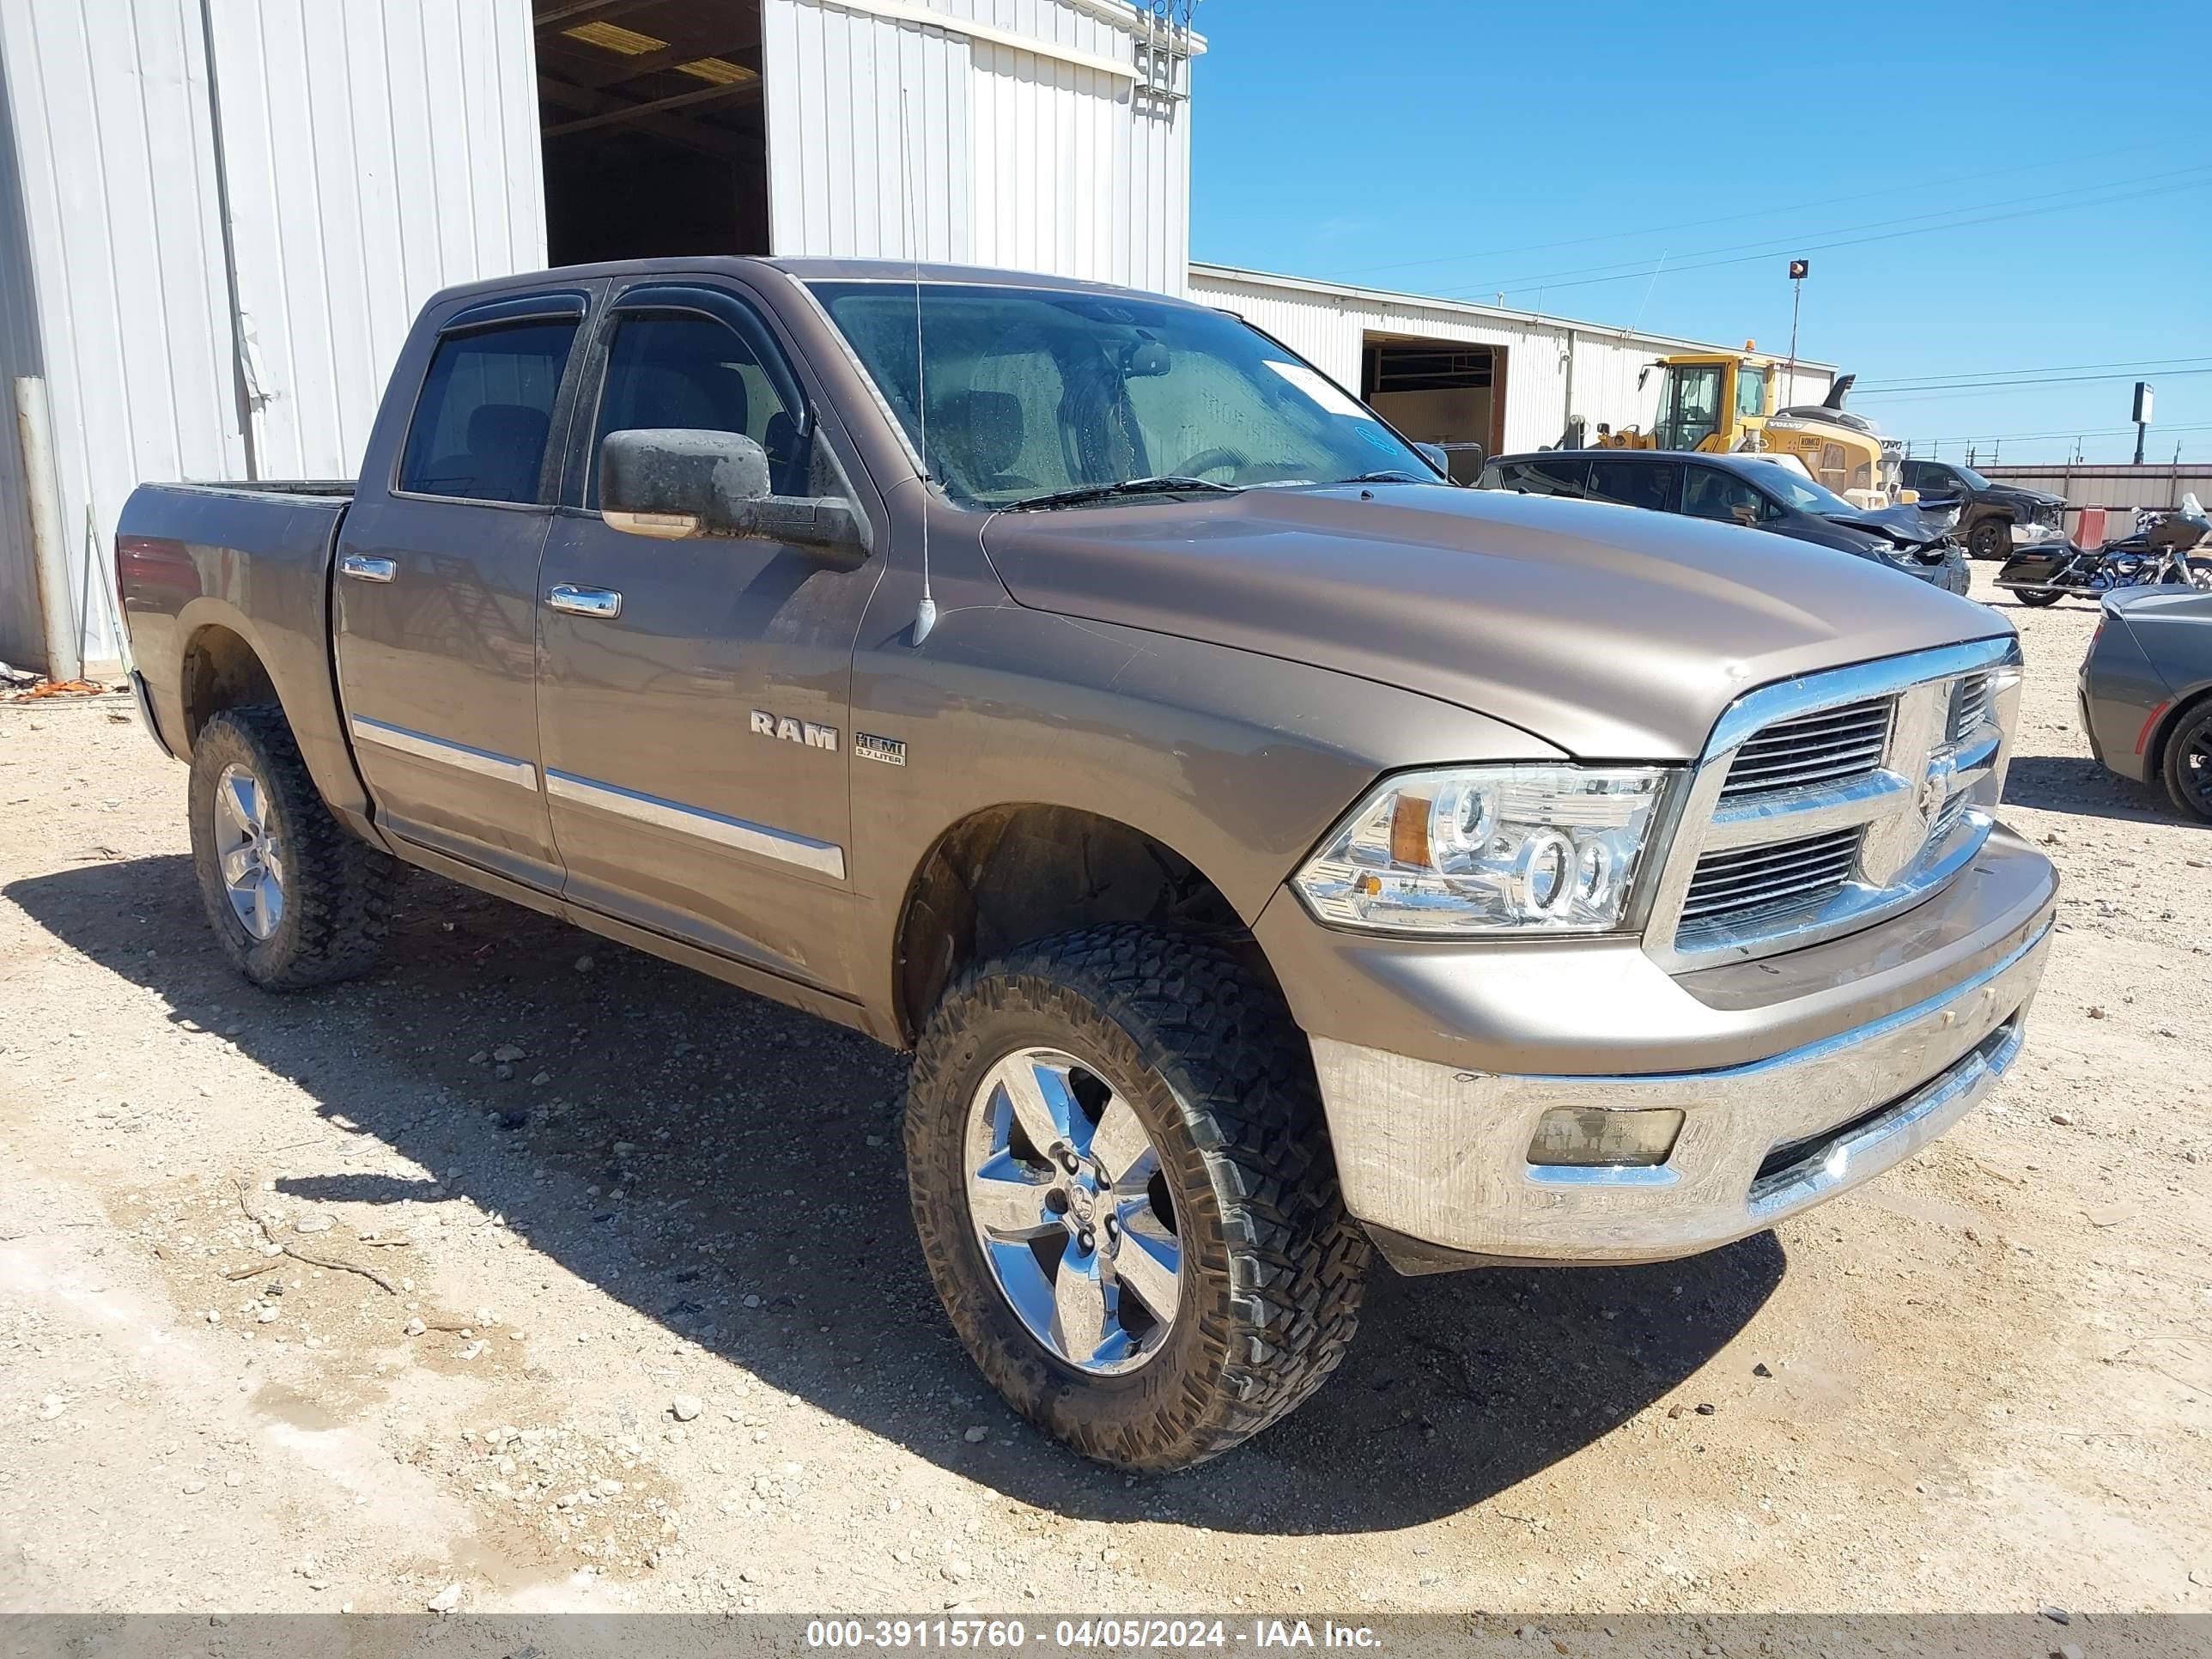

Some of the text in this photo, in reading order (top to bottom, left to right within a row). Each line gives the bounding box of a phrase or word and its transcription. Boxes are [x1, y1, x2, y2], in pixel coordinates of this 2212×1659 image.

[750, 709, 838, 752] RAM
[855, 733, 903, 755] HEMI
[874, 751, 902, 763] LITER
